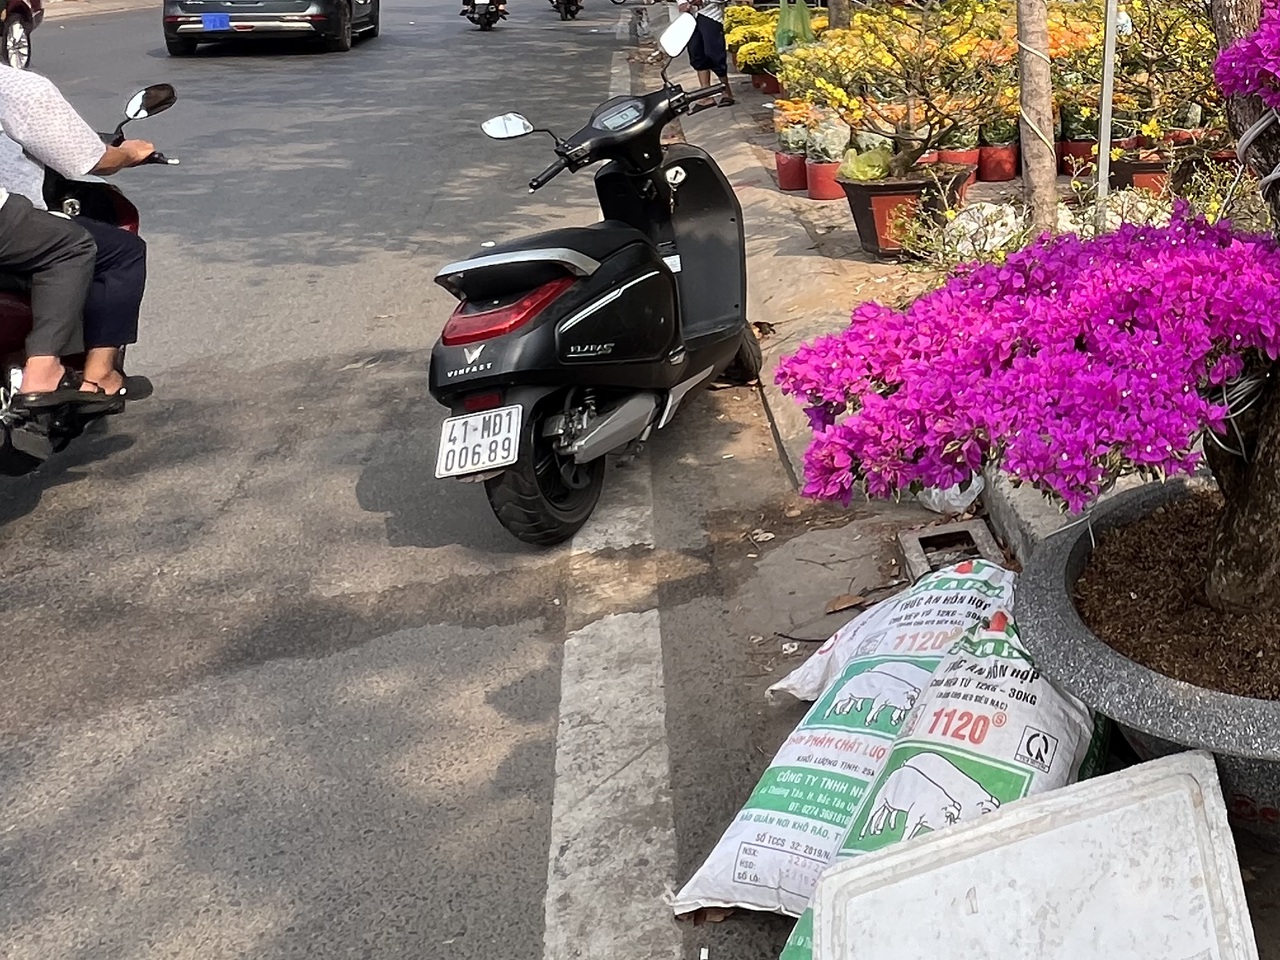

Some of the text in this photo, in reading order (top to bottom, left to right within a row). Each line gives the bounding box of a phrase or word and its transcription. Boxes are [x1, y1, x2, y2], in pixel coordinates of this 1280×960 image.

[447, 362, 492, 378] VINFAST
[445, 437, 511, 472] 006.89
[892, 630, 949, 651] 1120
[1008, 688, 1038, 706] 30KG
[928, 707, 991, 745] 1120
[776, 769, 801, 784] CÔNG
[806, 774, 819, 786] TY
[820, 777, 848, 794] TNHH
[802, 804, 820, 816] 0274
[791, 821, 810, 833] KHÔ
[755, 831, 768, 842] SỐ
[768, 835, 787, 847] TCCS
[742, 846, 759, 857] NSX:
